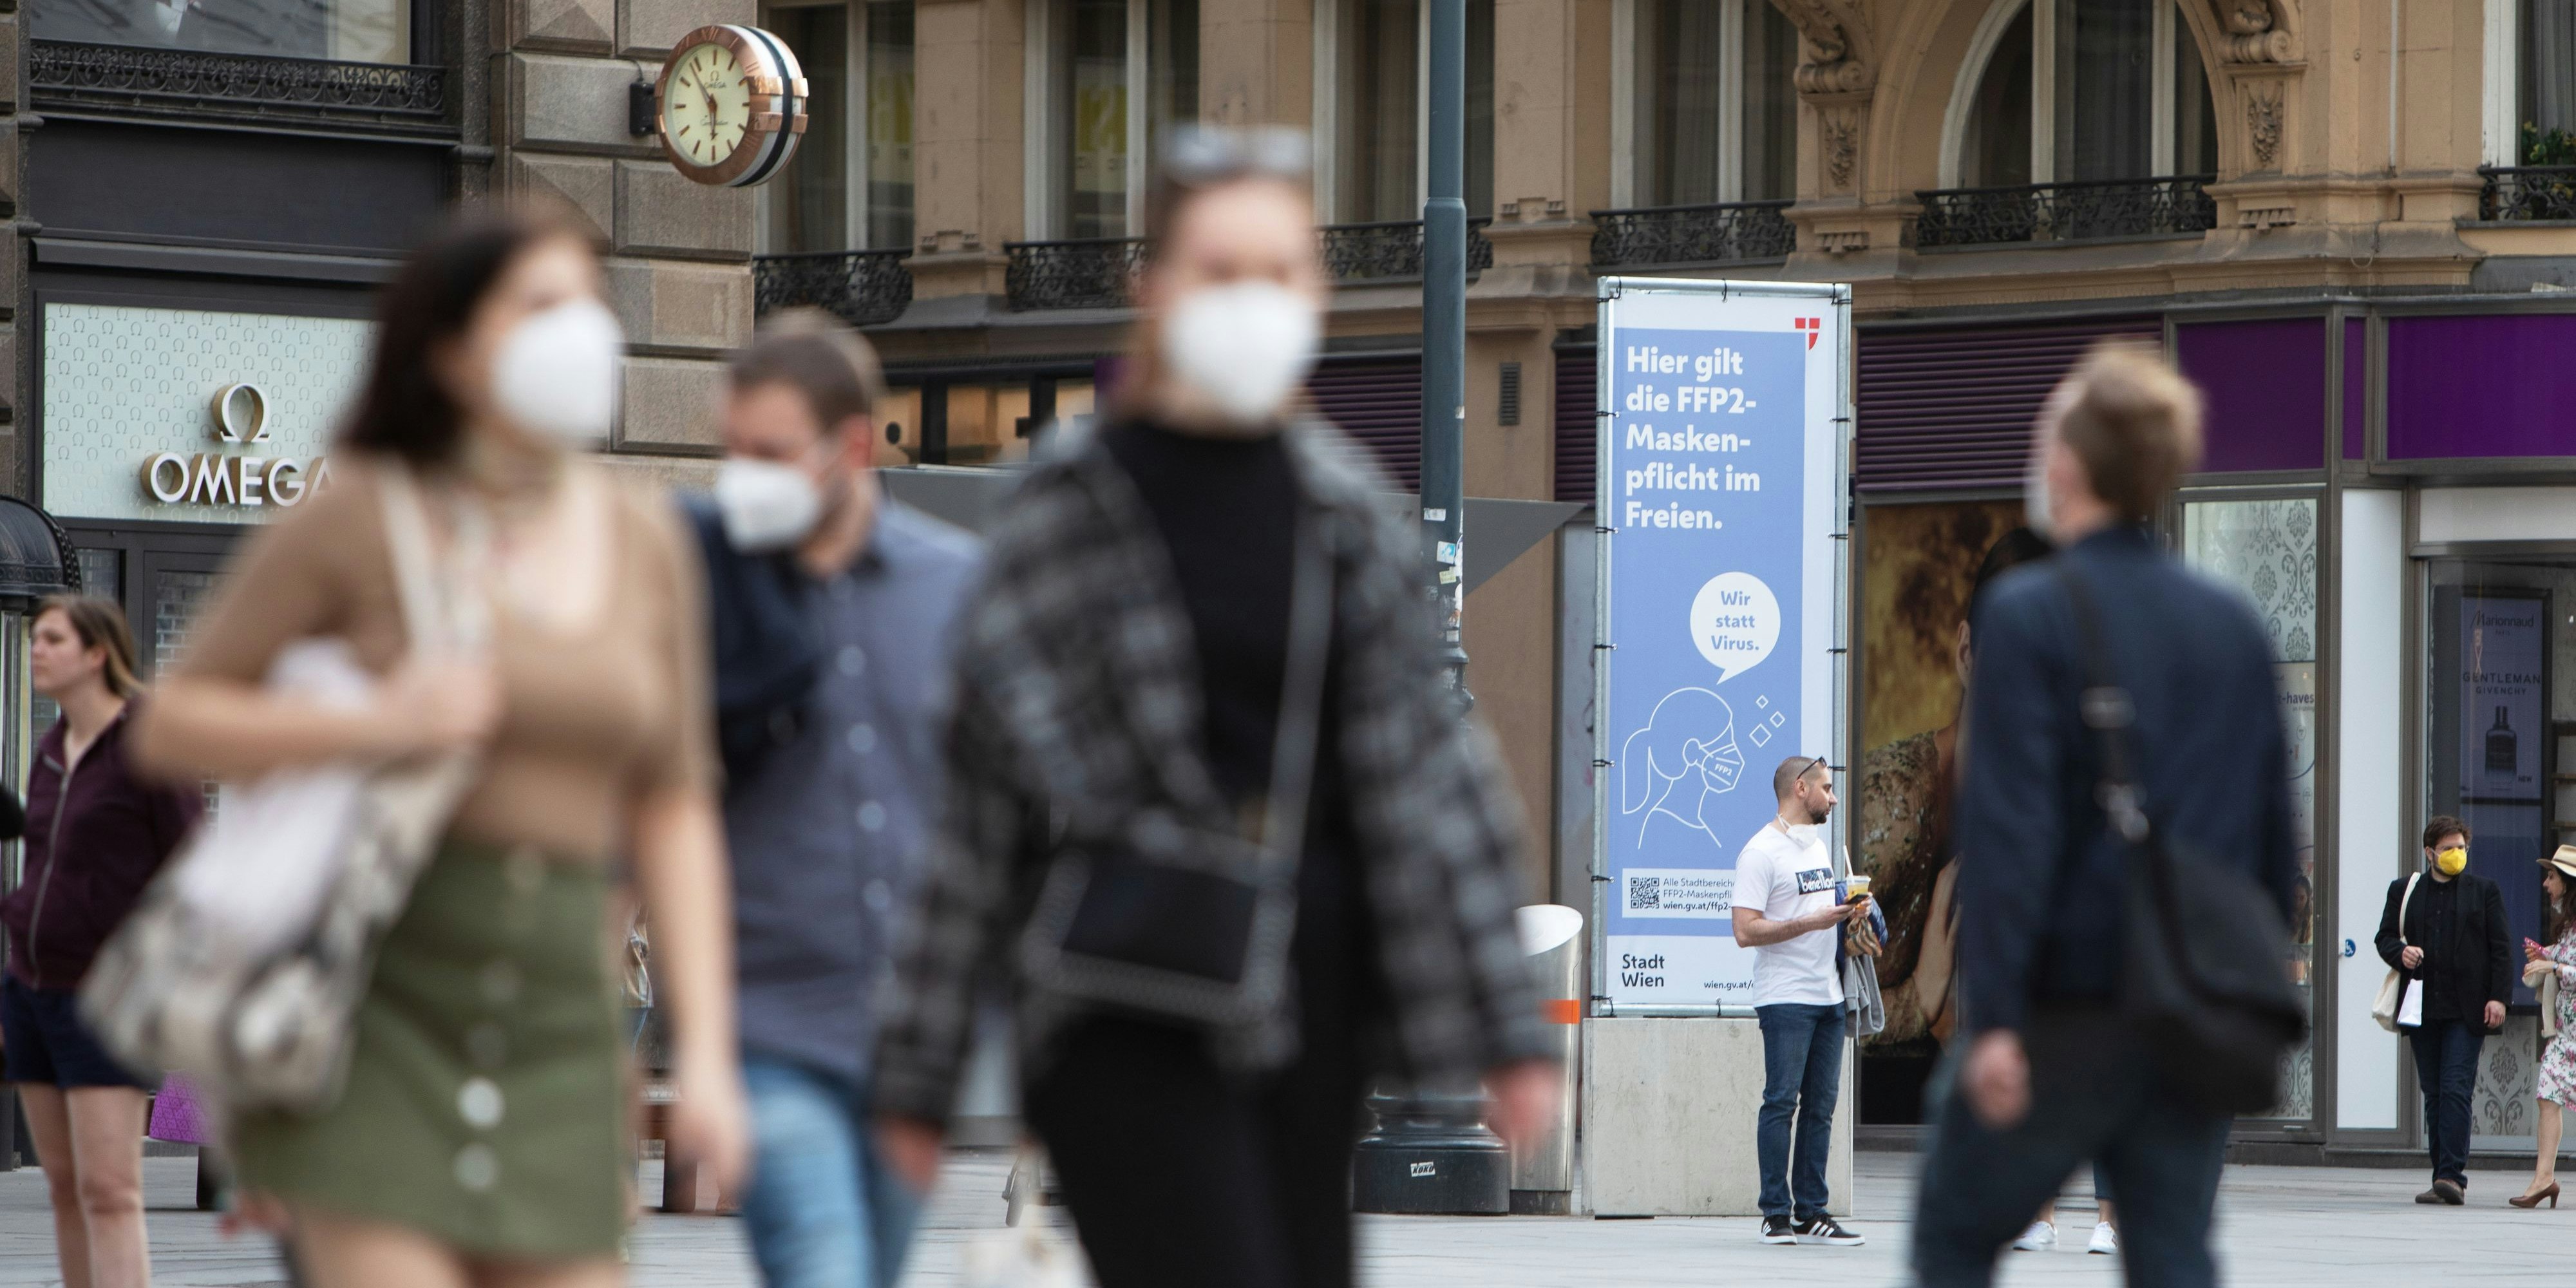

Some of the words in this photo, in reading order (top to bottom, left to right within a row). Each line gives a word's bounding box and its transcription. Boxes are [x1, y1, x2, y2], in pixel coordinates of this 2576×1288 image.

[1627, 346, 1688, 374] Hier
[1695, 347, 1743, 382] gilt
[1626, 384, 1670, 412] die
[1678, 386, 1757, 413] FFP2-
[1626, 423, 1750, 452] Masken-
[146, 451, 334, 507] OMEGA
[1626, 462, 1718, 497] pflicht
[1725, 464, 1760, 491] im
[1625, 501, 1723, 529] Freien.
[1721, 591, 1750, 606] Wir
[1716, 615, 1755, 628] statt
[2470, 609, 2534, 629] Marionnaud
[1710, 635, 1759, 650] Virus.
[2463, 671, 2541, 685] GENTLEMAN
[2278, 691, 2315, 704] t-haves
[2476, 686, 2526, 695] GIVENCHY
[1714, 763, 1732, 776] FFP2
[1663, 878, 1679, 887] Alle
[1663, 890, 1732, 900] FFP2-Maskenpfli
[1663, 901, 1731, 912] wien.gv.at/ffp2-
[1622, 953, 1665, 969] Stadt
[1622, 972, 1664, 987] Wien
